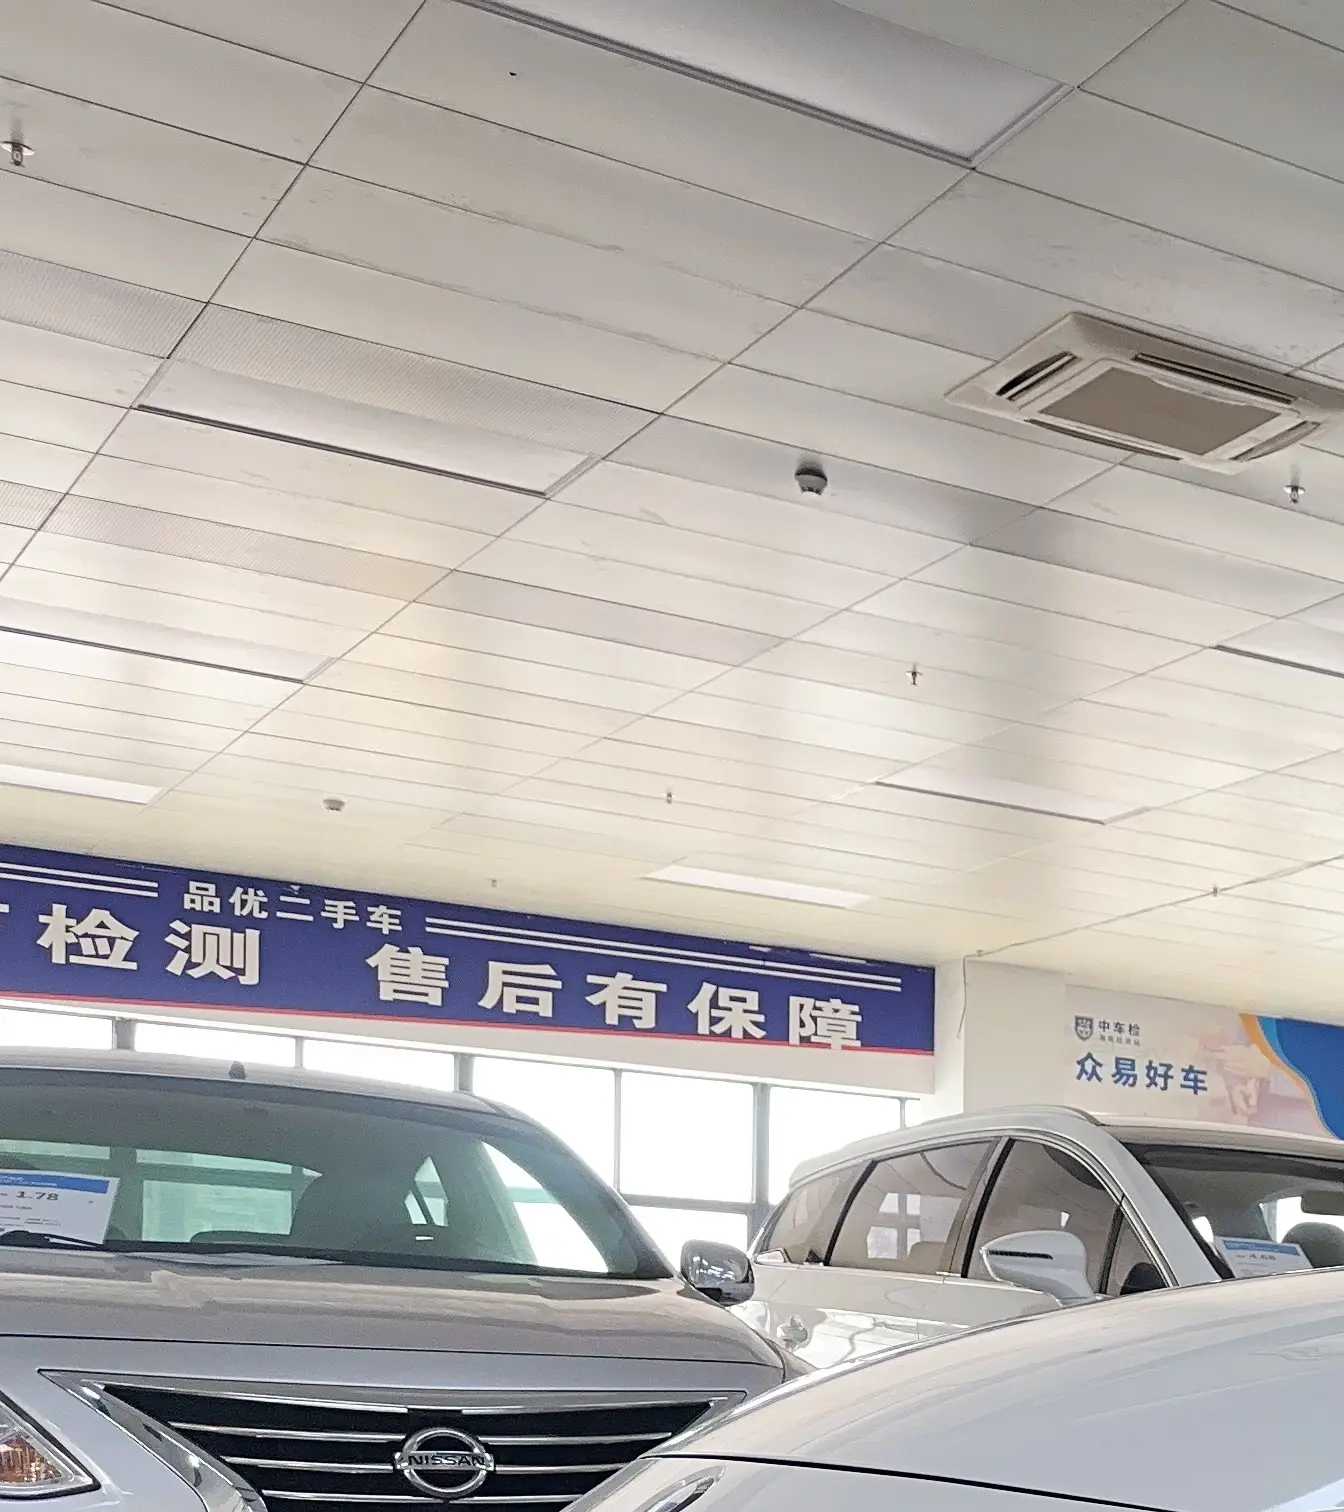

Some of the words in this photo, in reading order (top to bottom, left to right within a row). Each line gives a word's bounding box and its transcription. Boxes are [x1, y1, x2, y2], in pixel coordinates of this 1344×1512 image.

[183, 881, 403, 936] 品优二手车
[0, 903, 261, 986] 检测
[365, 943, 863, 1050] 售后有保障
[1075, 1052, 1208, 1095] 众易好车
[408, 1455, 485, 1467] NISSAN
